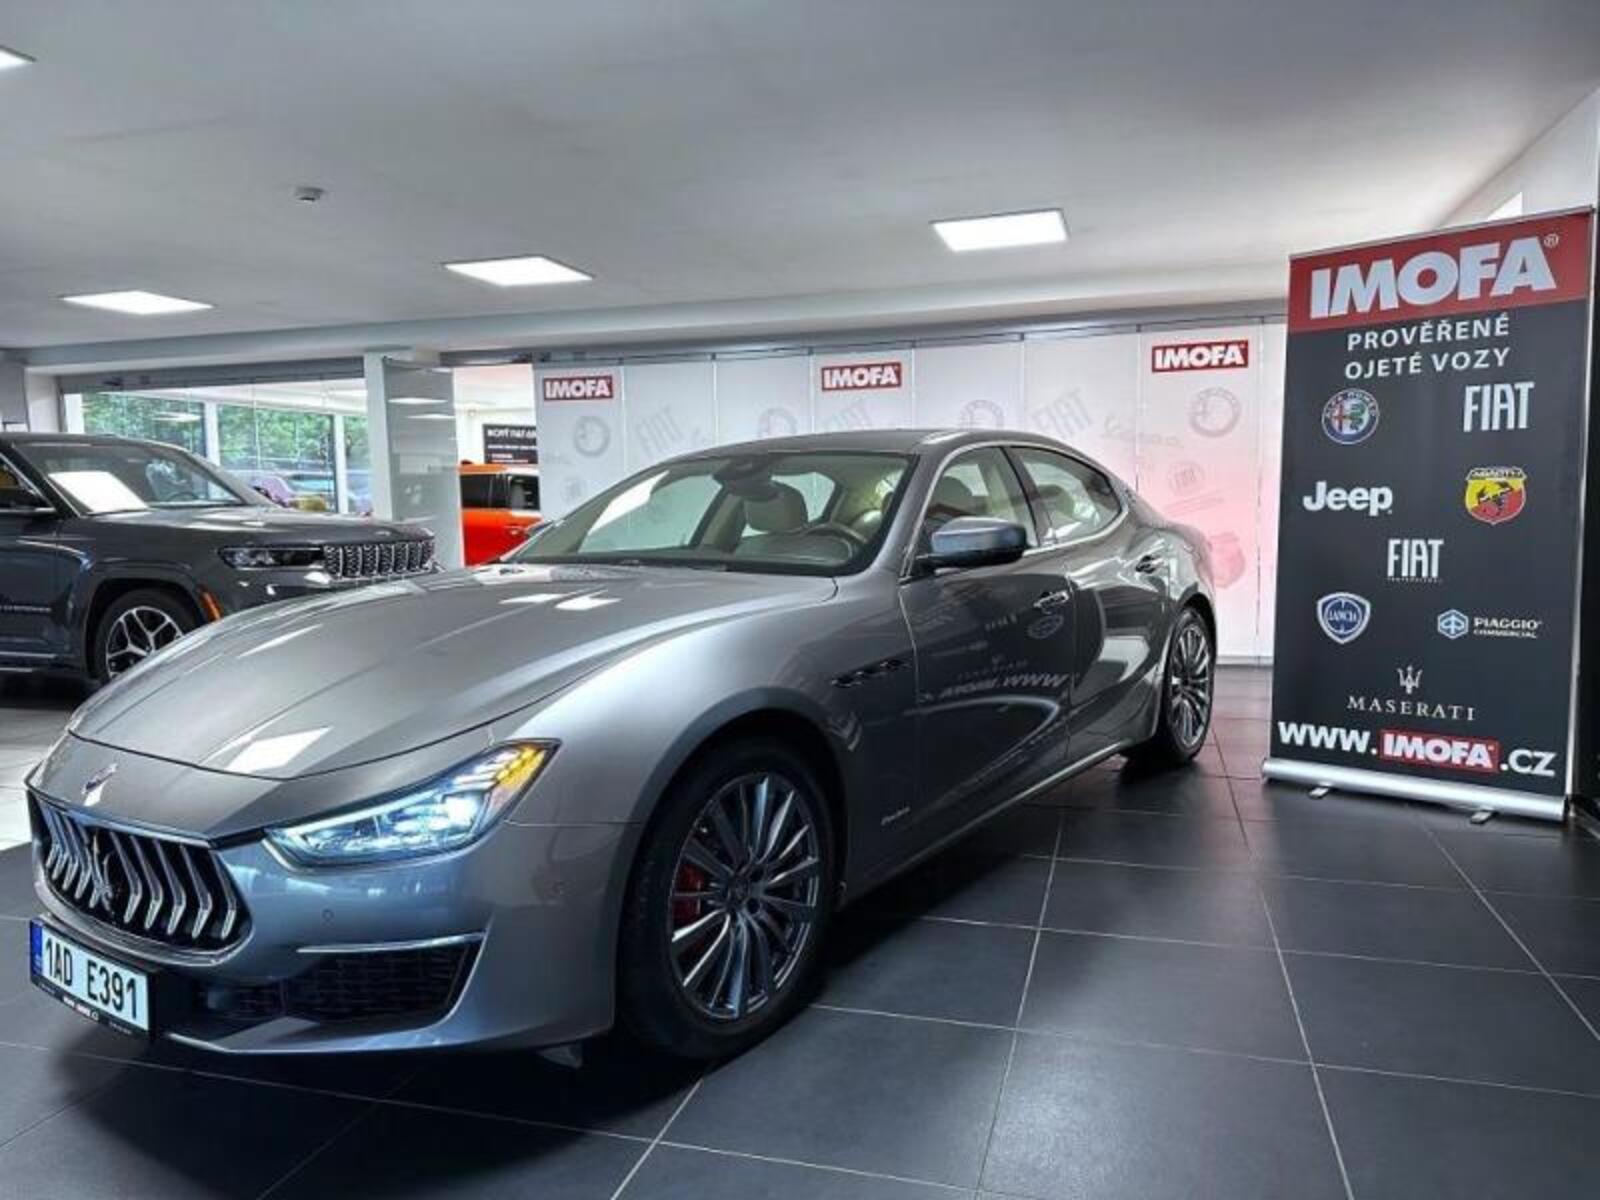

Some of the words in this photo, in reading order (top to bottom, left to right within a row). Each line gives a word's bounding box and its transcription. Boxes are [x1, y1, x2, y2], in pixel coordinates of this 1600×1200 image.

[1347, 312, 1511, 352] PROVĚŘENÉ
[1154, 343, 1245, 370] IMOFA
[1345, 354, 1423, 380] OJETÉ
[1431, 347, 1511, 373] VOZY
[544, 378, 611, 399] IMOFA
[823, 365, 899, 389] IMOFA
[1463, 382, 1535, 432] FIAT
[1303, 481, 1393, 516] Jeep
[1387, 538, 1444, 578] FIAT
[1473, 617, 1538, 631] PIAGGIO
[1346, 695, 1476, 721] MASERATI
[46, 938, 73, 987] 1AD
[87, 959, 138, 1020] E391
